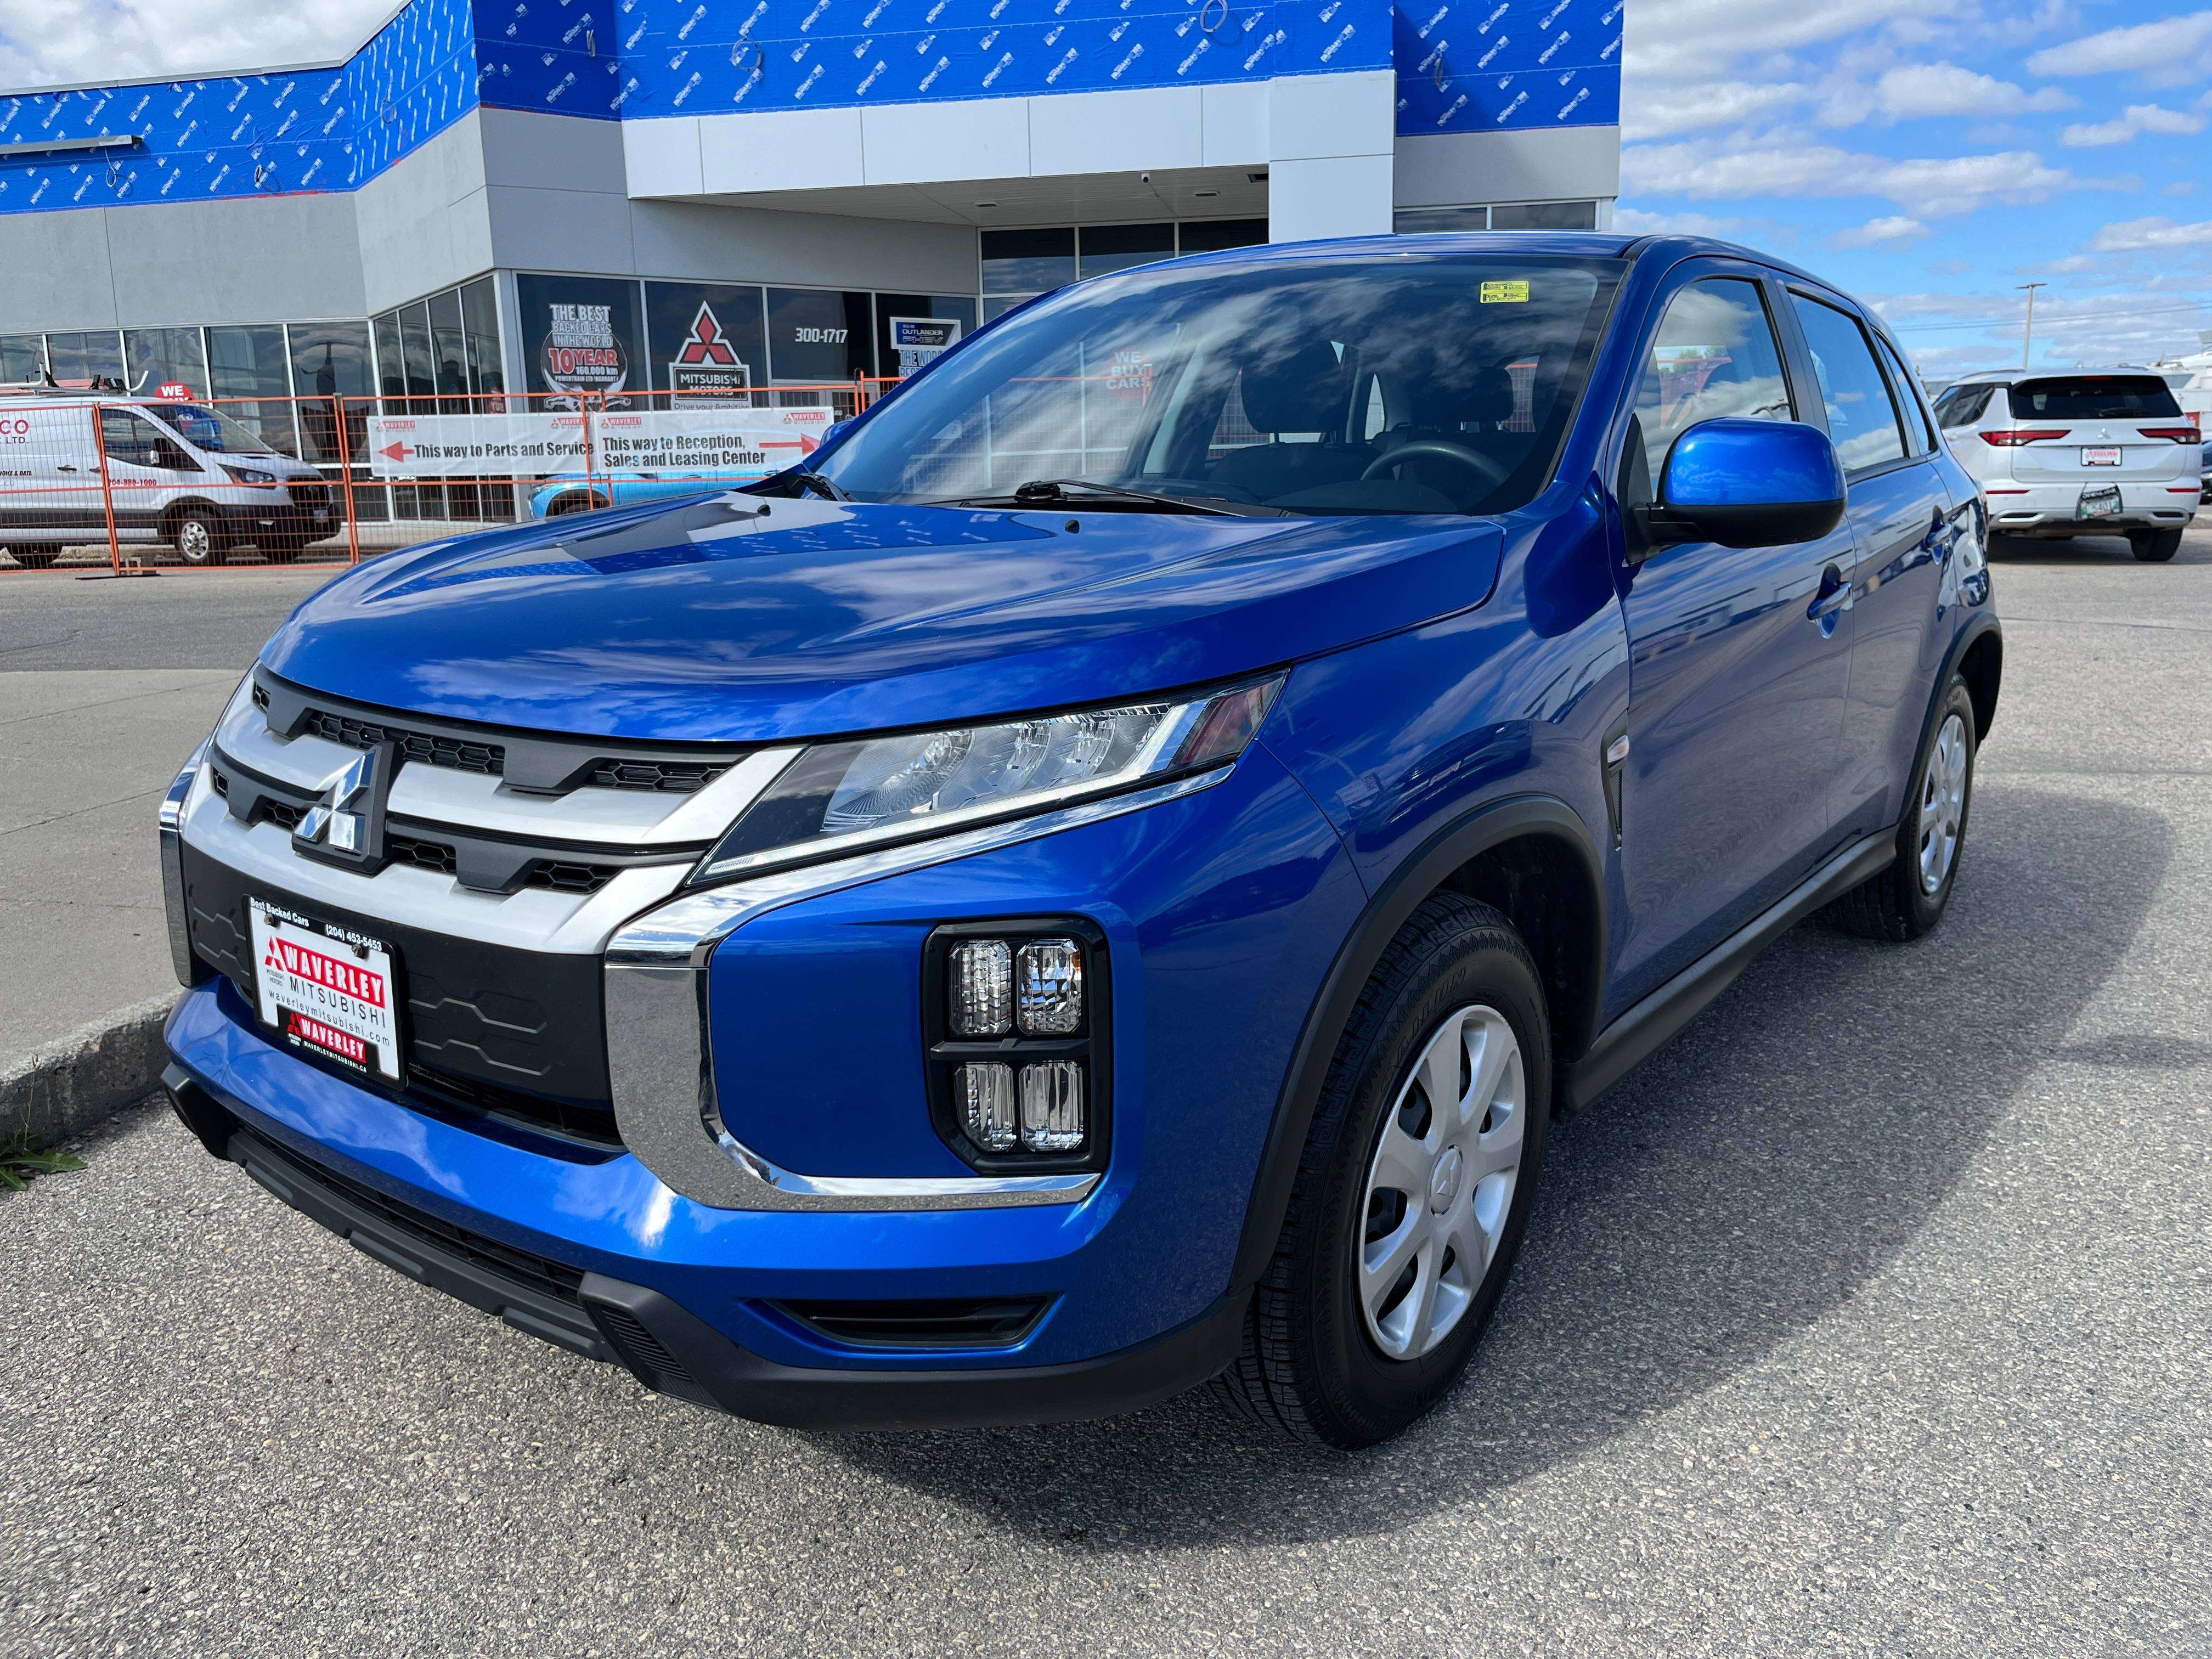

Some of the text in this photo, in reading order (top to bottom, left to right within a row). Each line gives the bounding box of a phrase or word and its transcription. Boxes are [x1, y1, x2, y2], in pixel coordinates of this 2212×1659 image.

[550, 304, 611, 322] THE BEST
[552, 321, 612, 334] BACKED CARS
[794, 328, 848, 343] 300-1717
[582, 335, 614, 347] WORLD
[549, 348, 619, 374] 10 YEAR
[900, 349, 917, 365] THE
[1115, 352, 1142, 363] WE
[606, 367, 618, 375] km
[680, 374, 741, 385] MITSUBISHI
[1107, 377, 1150, 390] CARS
[161, 385, 184, 397] WE
[690, 385, 734, 396] MOTORS
[610, 417, 641, 425] WAVERLEY
[414, 442, 594, 459] This way to Parts and Service
[603, 435, 746, 451] This way to Reception,
[605, 450, 766, 467] Sales and Leasing Center
[250, 897, 309, 927] Best Backed Cars
[326, 924, 382, 951] (204) 453-5453
[284, 944, 382, 1003] WAVERLEY
[290, 976, 386, 1028] MITSUBISHI
[268, 989, 390, 1046] waverleymitsubishi.com
[300, 1018, 365, 1059] WAVERLEY
[303, 1040, 367, 1073] WAVERLEYMITSUBISHI.CA
